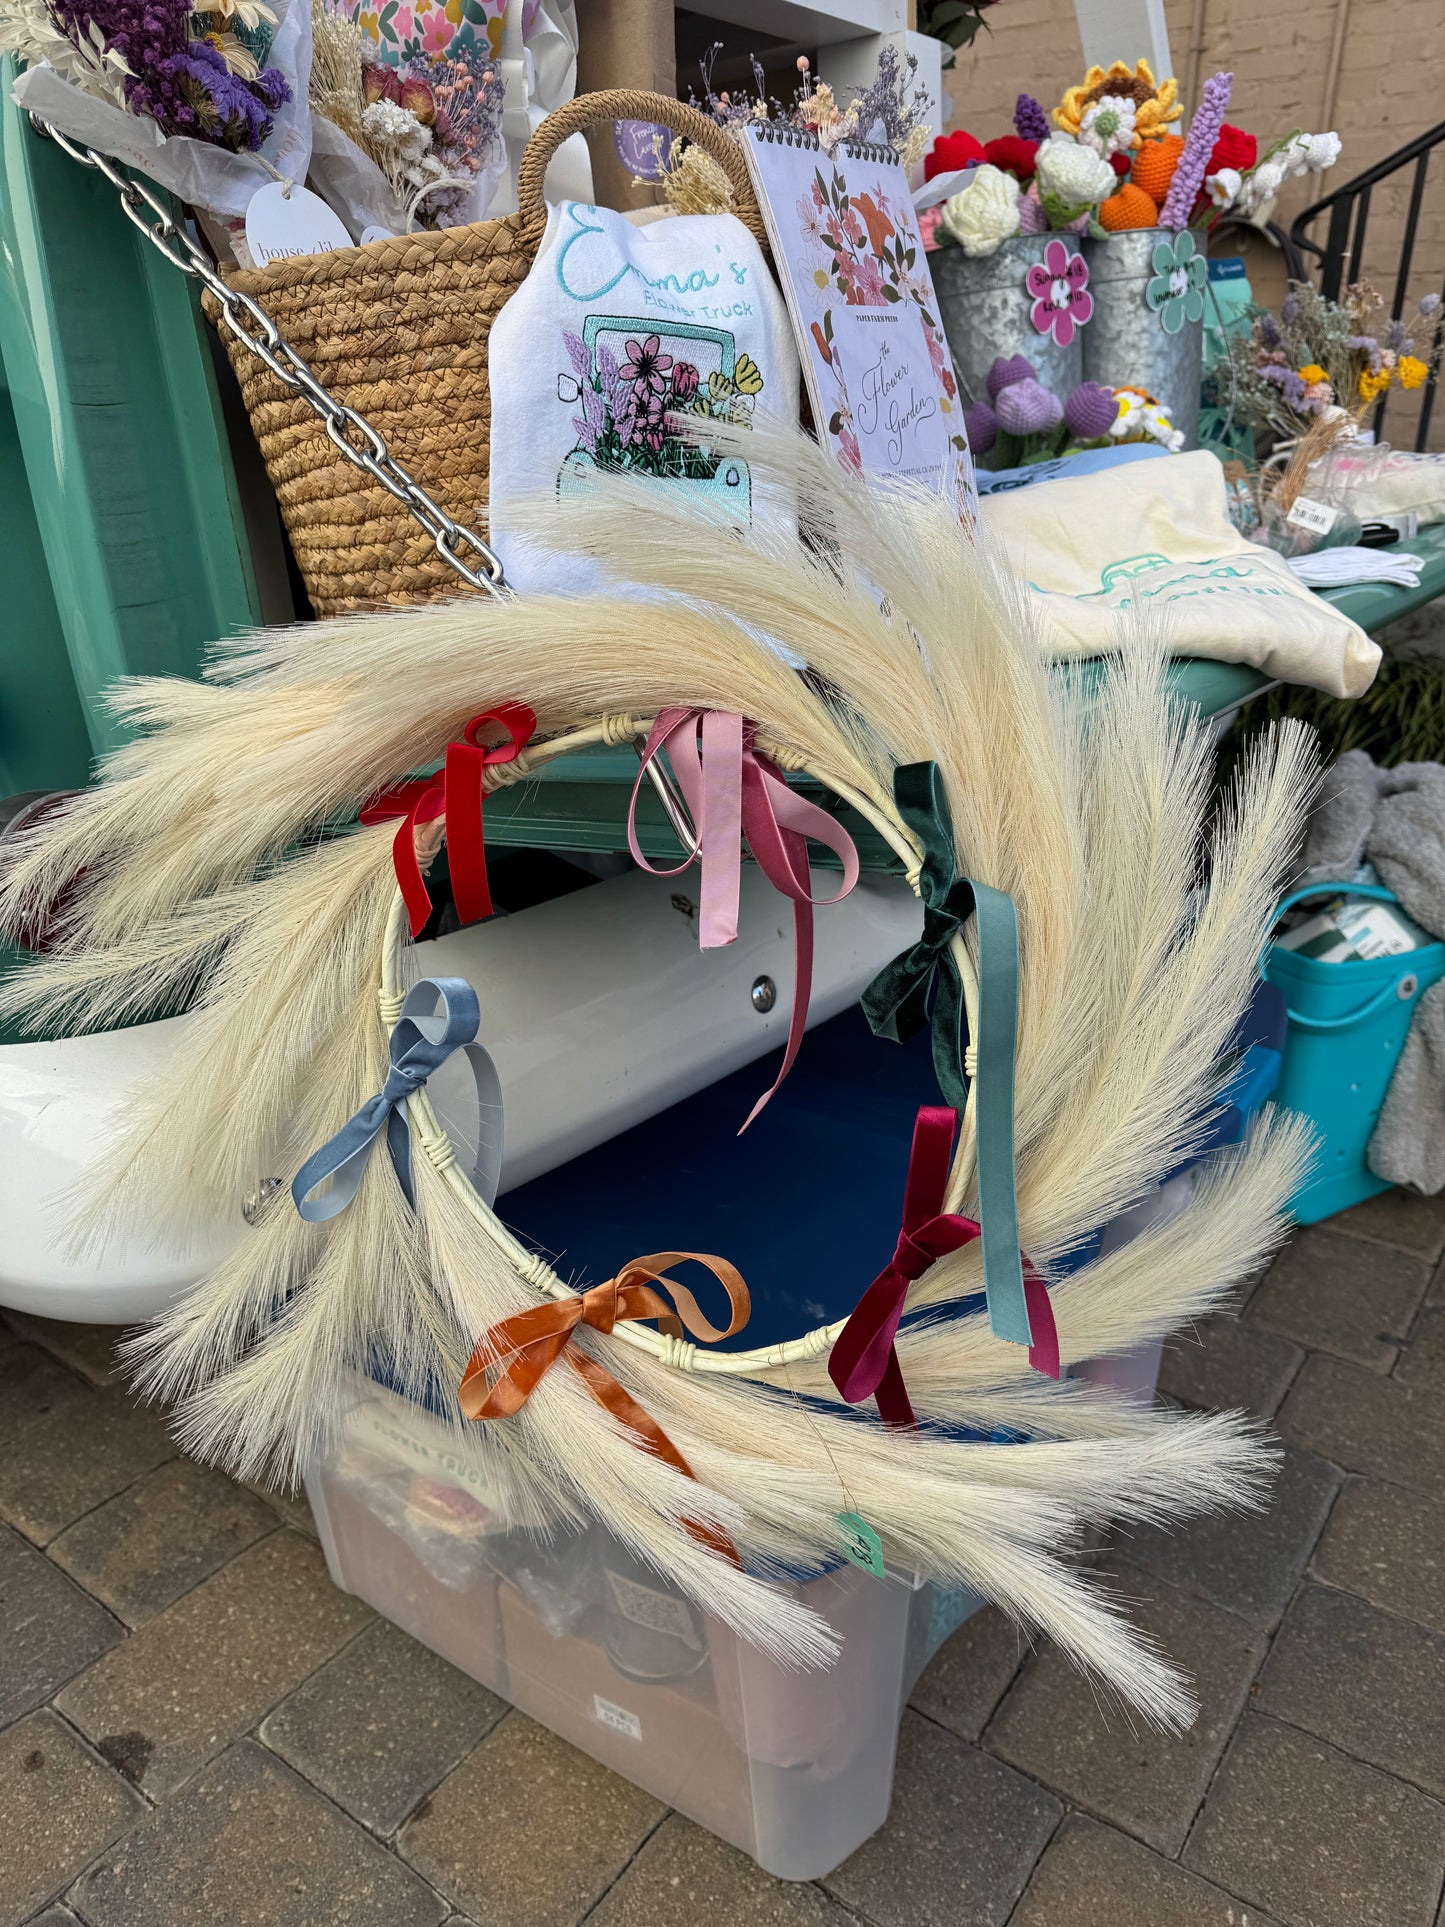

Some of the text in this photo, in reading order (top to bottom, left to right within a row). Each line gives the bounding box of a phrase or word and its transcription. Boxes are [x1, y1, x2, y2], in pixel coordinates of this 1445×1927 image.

[855, 314, 898, 323] PAPER FARM PRESS
[879, 340, 891, 360] the
[857, 356, 909, 435] Flower
[884, 386, 937, 466] Garden
